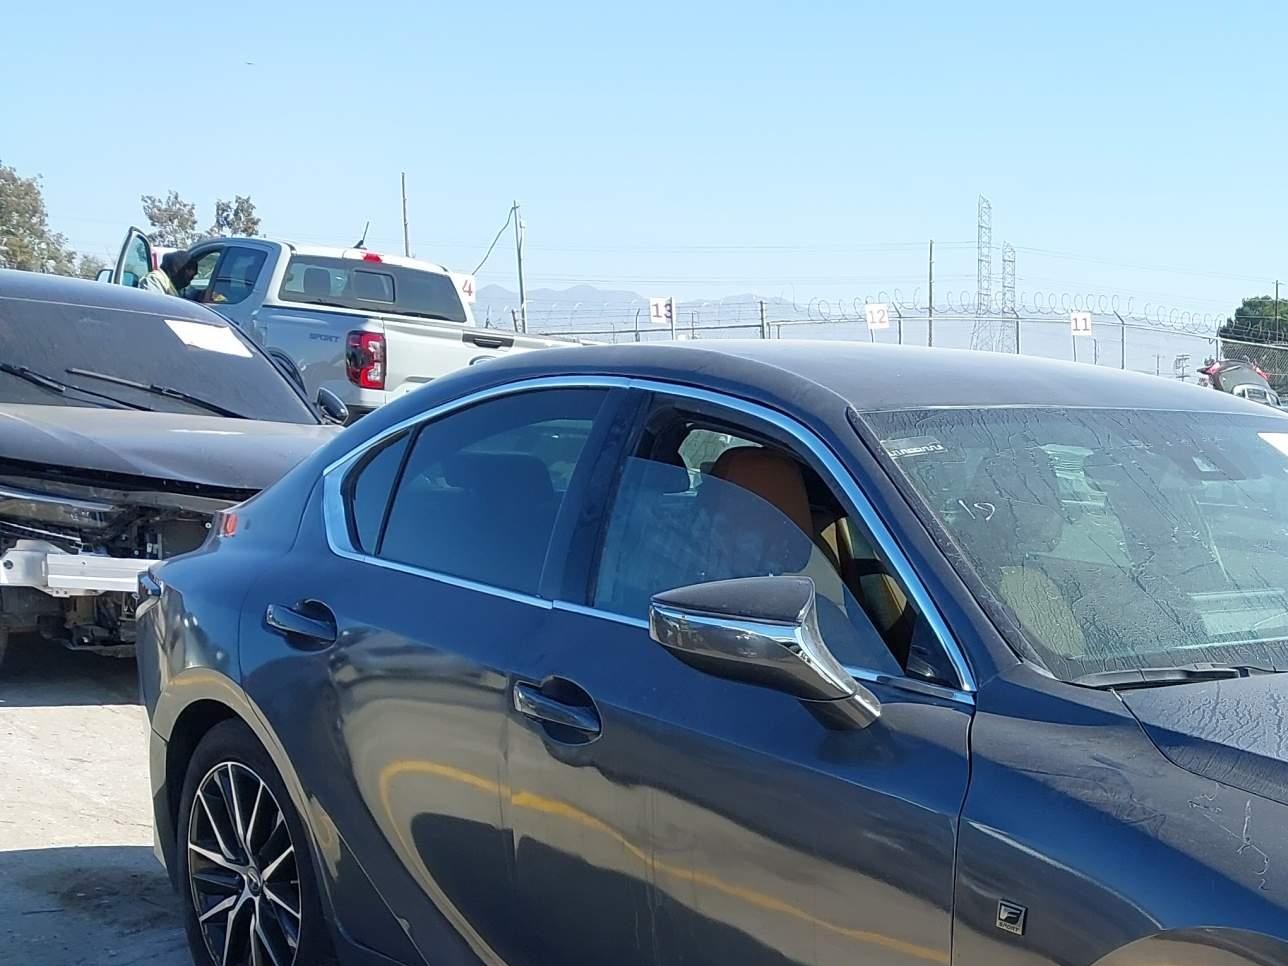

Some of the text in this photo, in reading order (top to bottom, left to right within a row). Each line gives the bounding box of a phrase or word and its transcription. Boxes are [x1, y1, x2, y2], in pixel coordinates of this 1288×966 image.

[651, 303, 673, 319] 13
[868, 309, 887, 324] 12
[1072, 317, 1091, 331] 11
